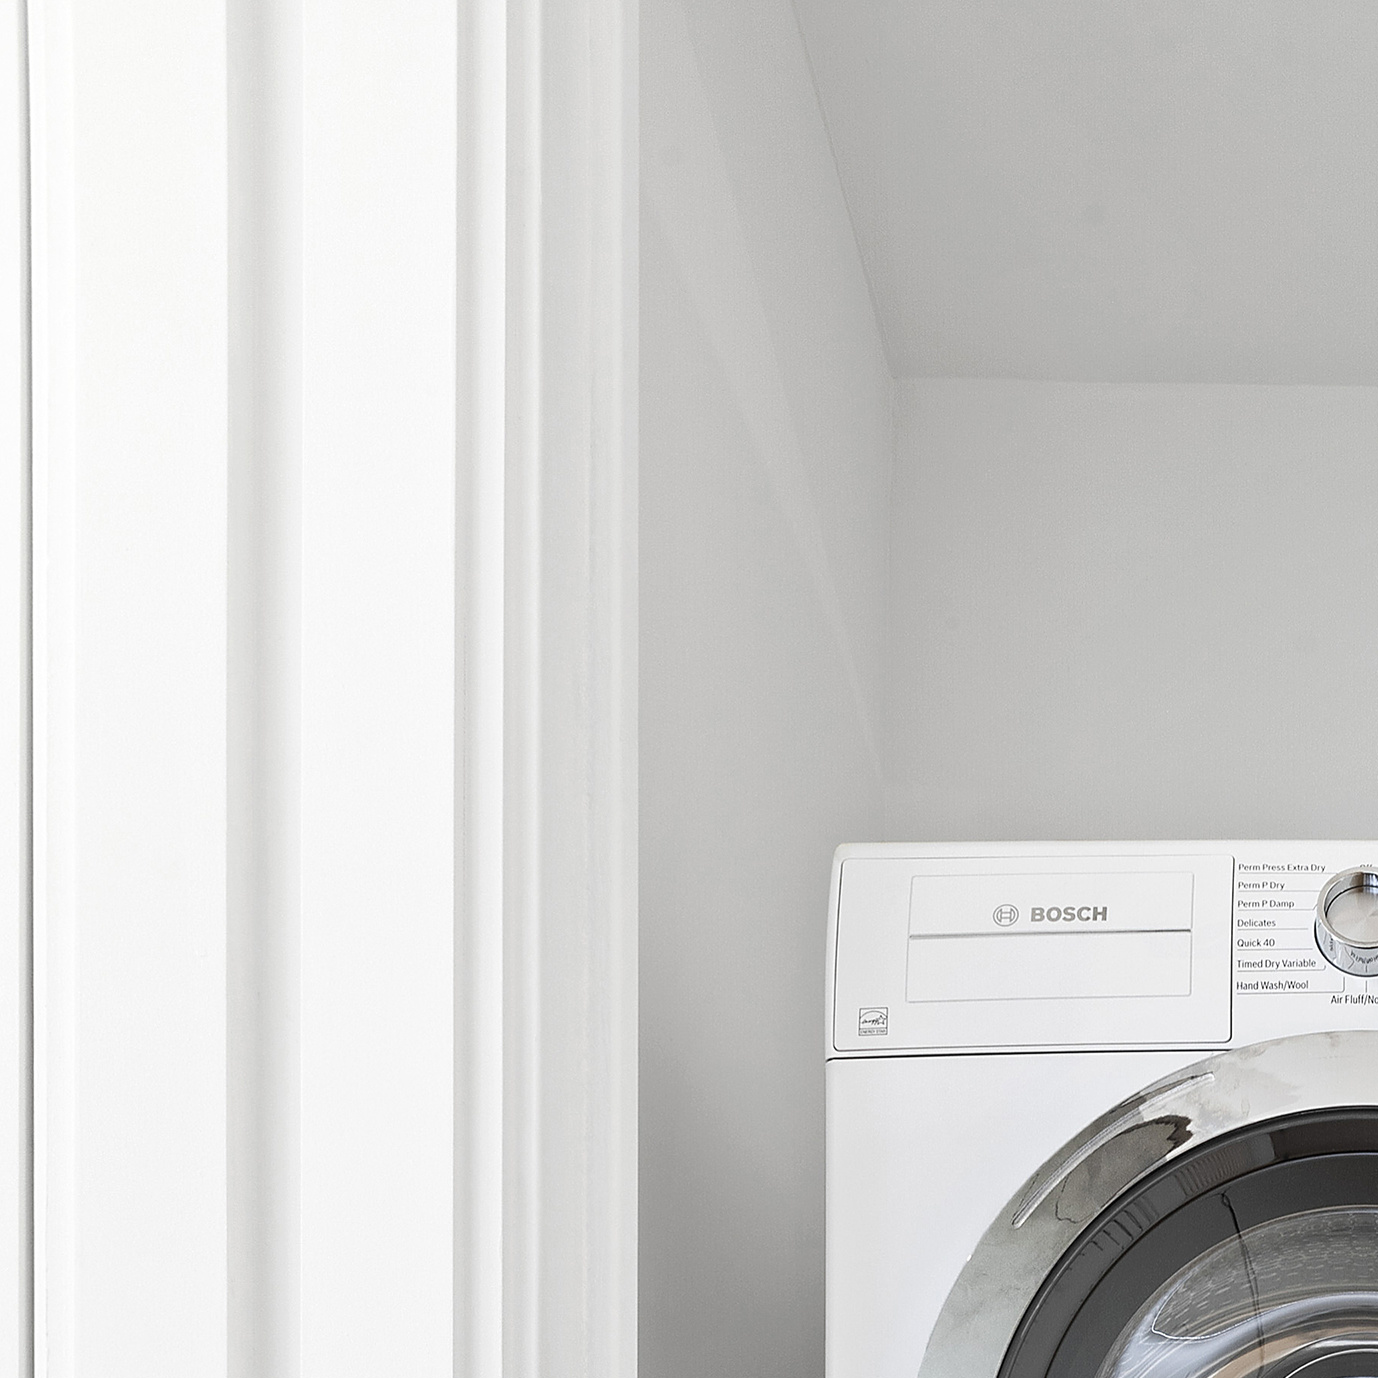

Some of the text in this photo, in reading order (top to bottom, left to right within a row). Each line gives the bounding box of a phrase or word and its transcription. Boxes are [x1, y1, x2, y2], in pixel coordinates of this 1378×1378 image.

[1311, 864, 1325, 872] Dry
[1270, 882, 1285, 890] Dry
[1270, 900, 1294, 908] Damp
[1031, 907, 1107, 922] BOSCH
[1237, 919, 1276, 927] Delicates
[1237, 939, 1275, 947] Quick 40
[1237, 959, 1316, 970] Timed Dry Variable
[1237, 980, 1308, 990] Hand Wash/Wool
[1331, 995, 1343, 1004] Air
[1345, 994, 1378, 1005] Fluff/No
